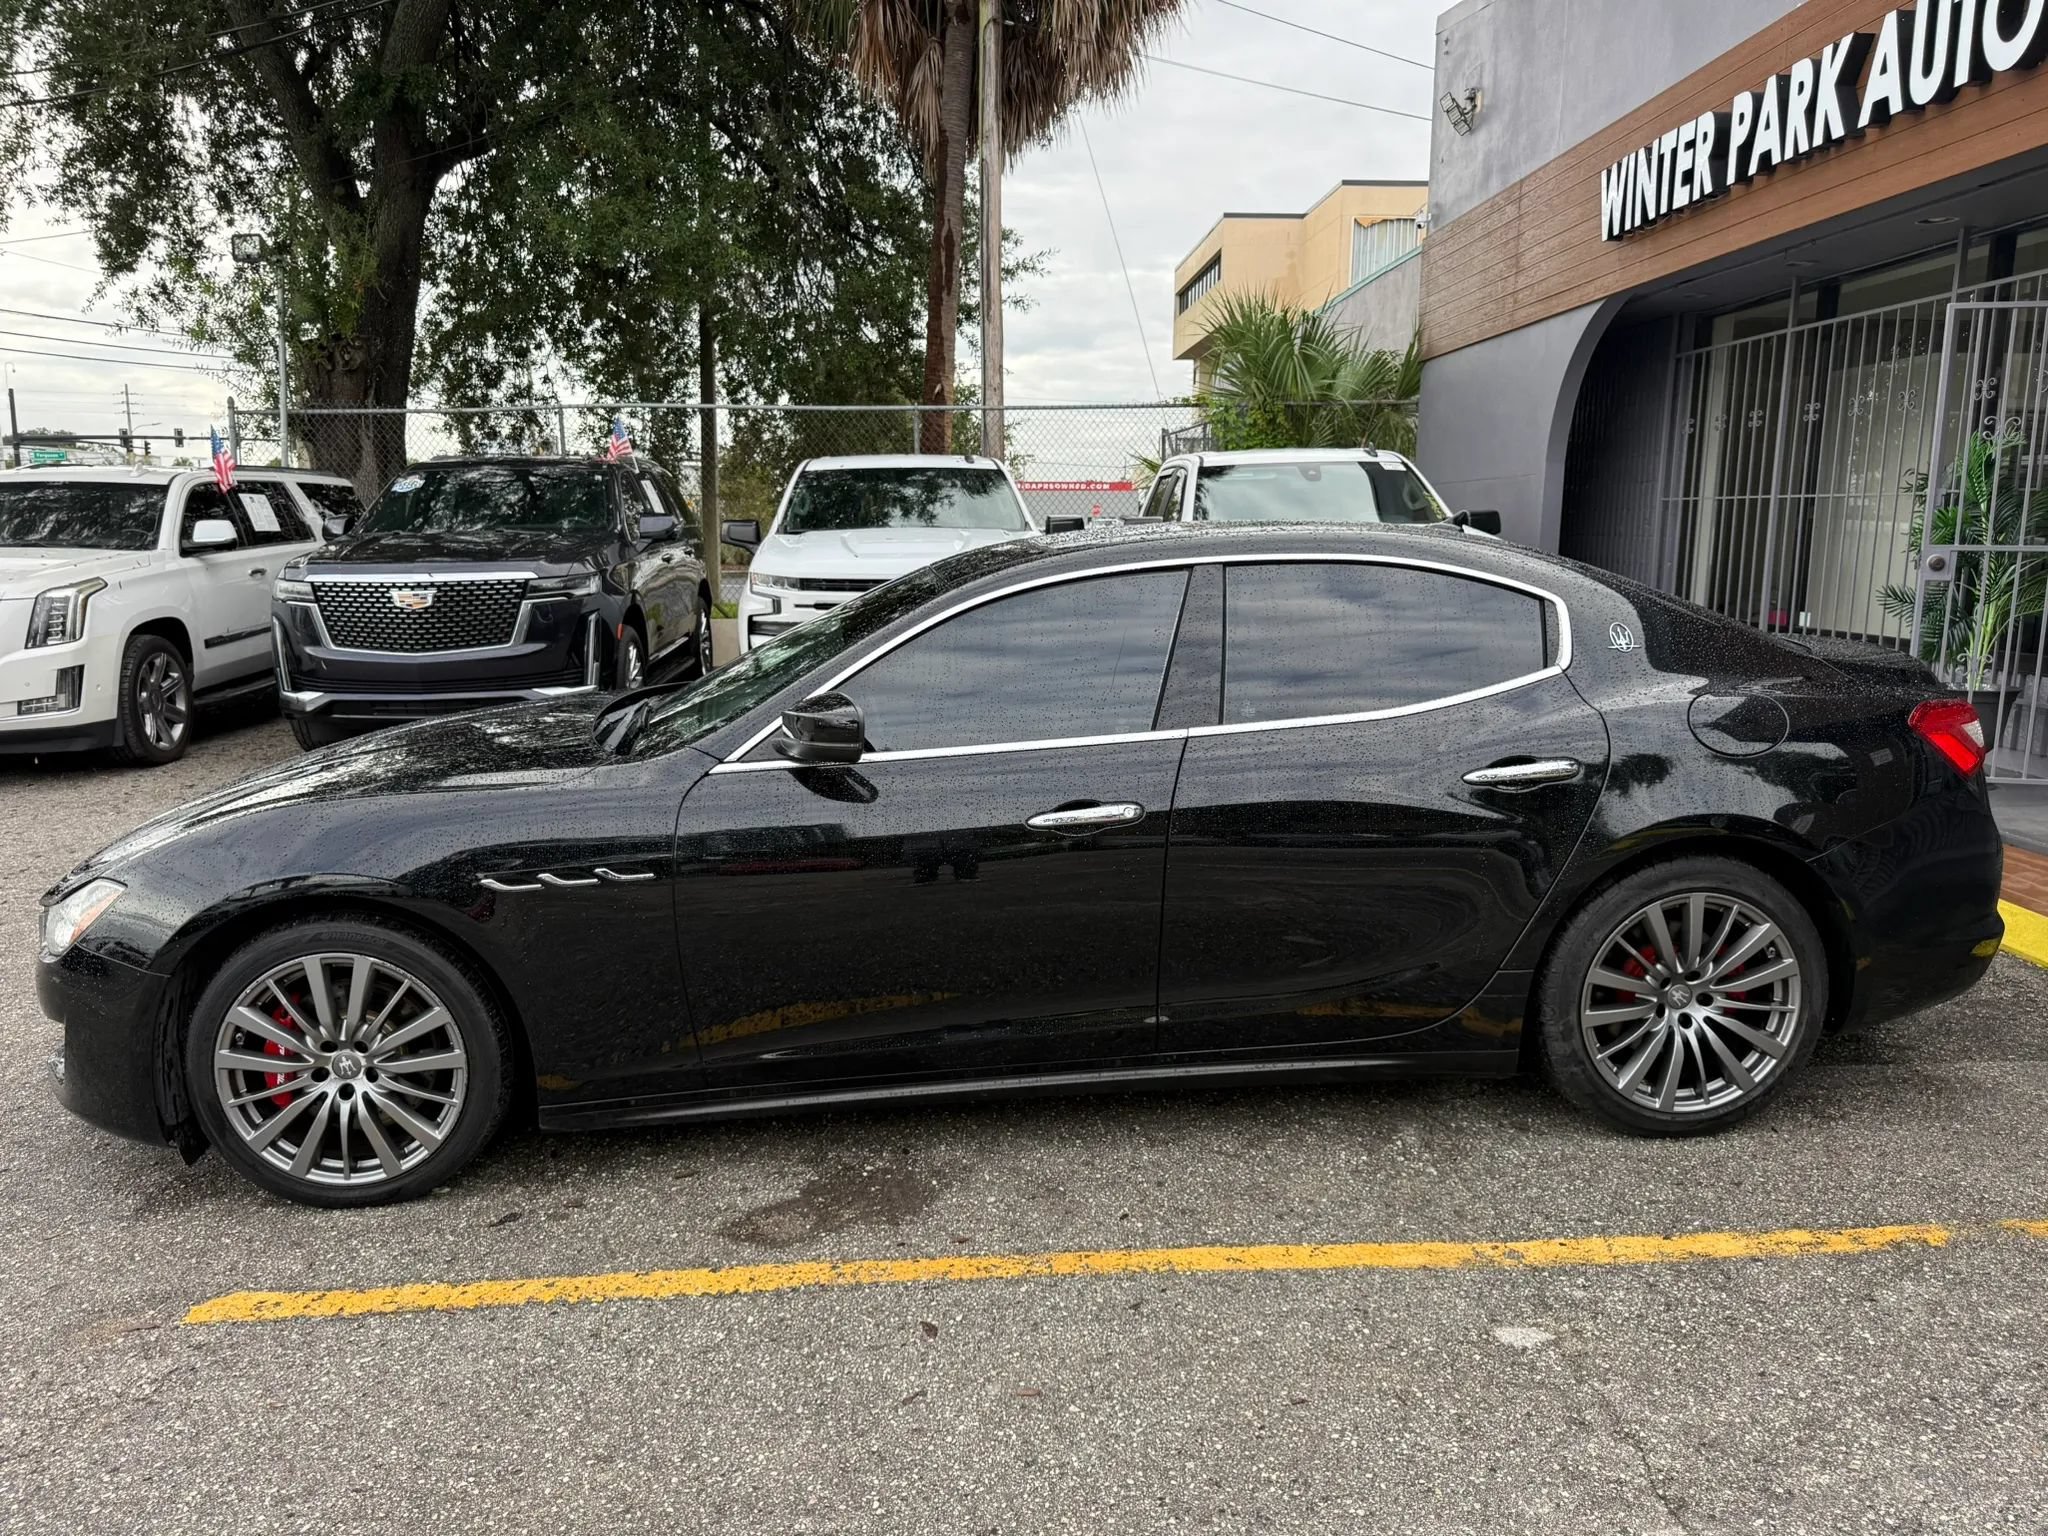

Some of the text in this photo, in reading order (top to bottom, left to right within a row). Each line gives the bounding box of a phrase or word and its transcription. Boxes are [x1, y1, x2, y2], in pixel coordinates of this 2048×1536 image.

[1601, 0, 2046, 241] WINTER PARK AUTO
